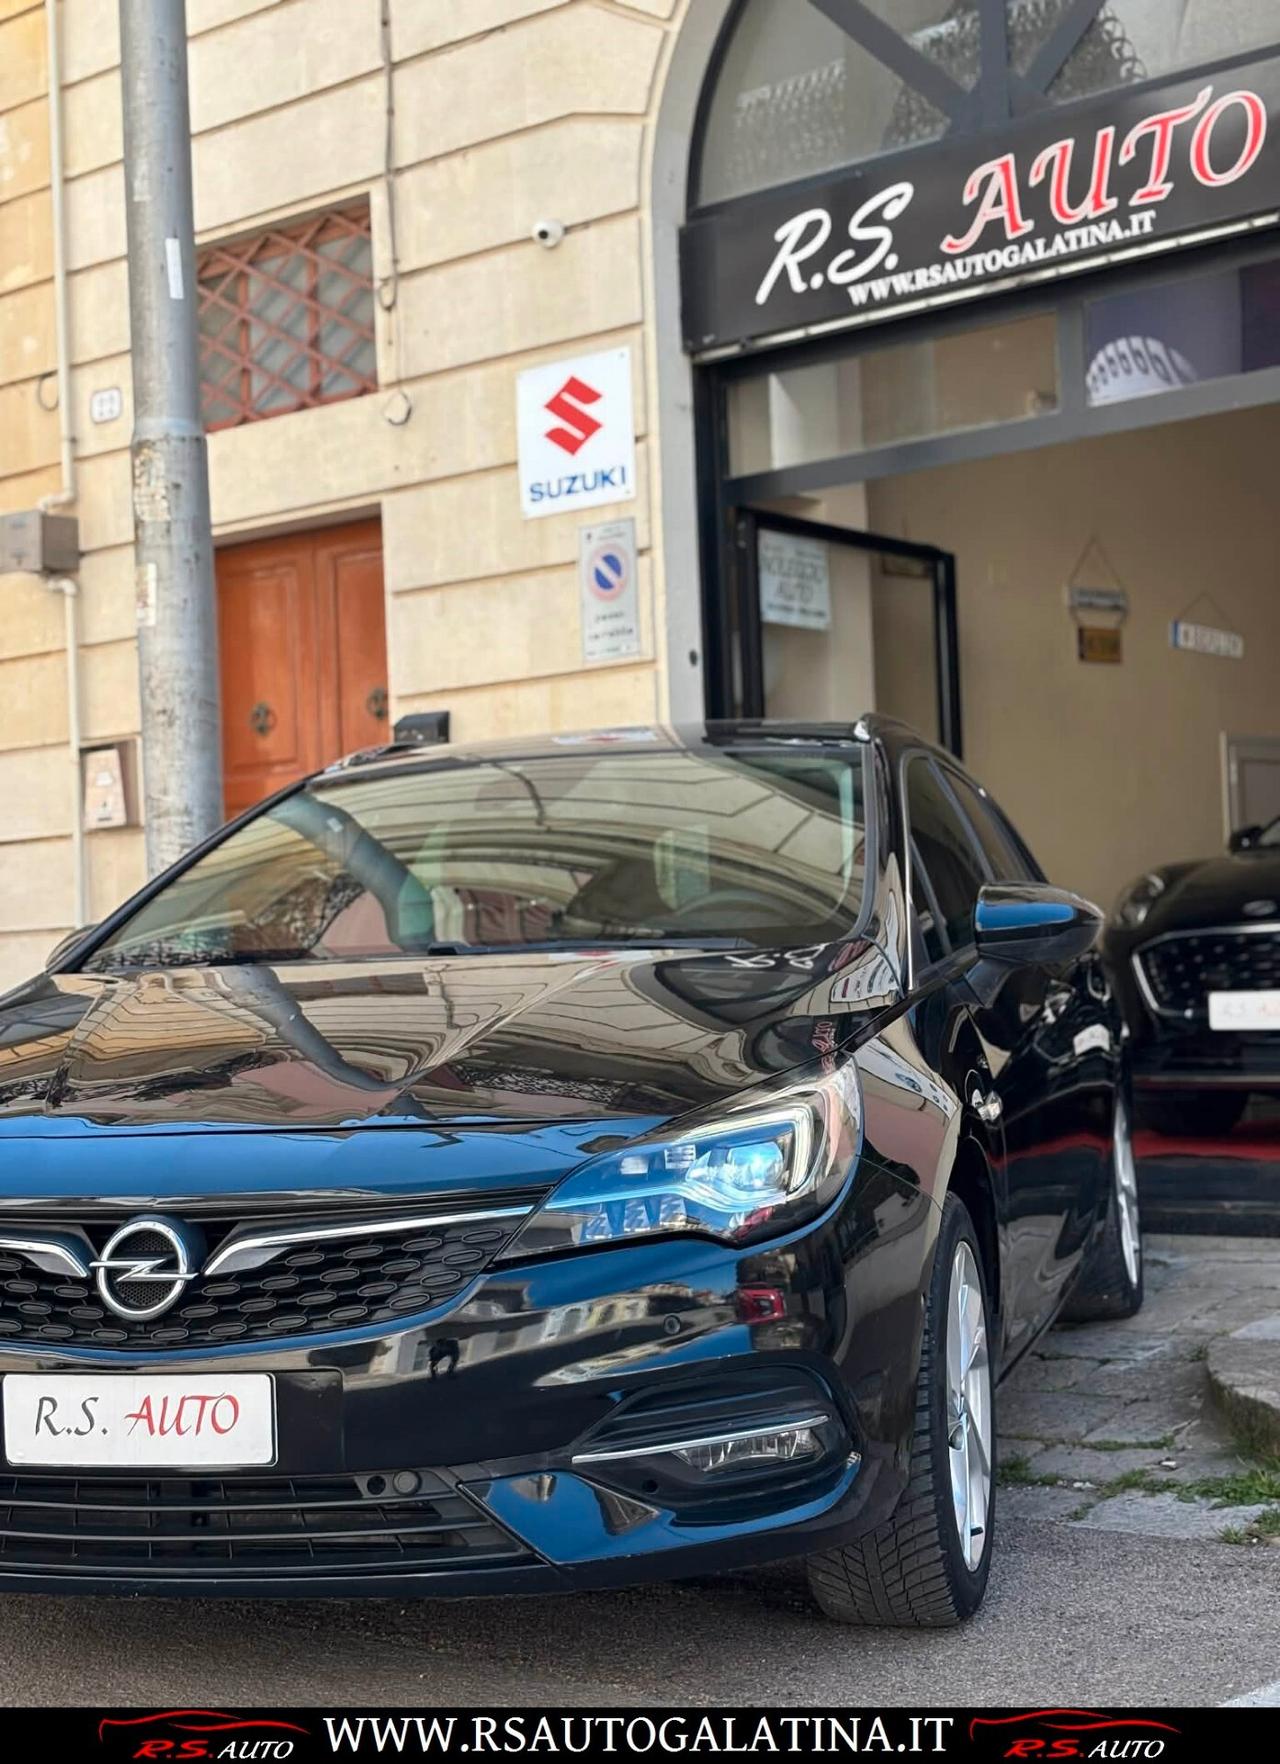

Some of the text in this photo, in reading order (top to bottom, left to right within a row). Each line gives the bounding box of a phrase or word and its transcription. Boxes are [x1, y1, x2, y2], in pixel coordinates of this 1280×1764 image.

[755, 86, 1267, 305] R.S. AUTO
[847, 210, 1156, 306] WWW.RSAUTOGALATINA.IT
[529, 465, 627, 503] SUZUKI
[34, 1392, 240, 1437] R.S. AUTO
